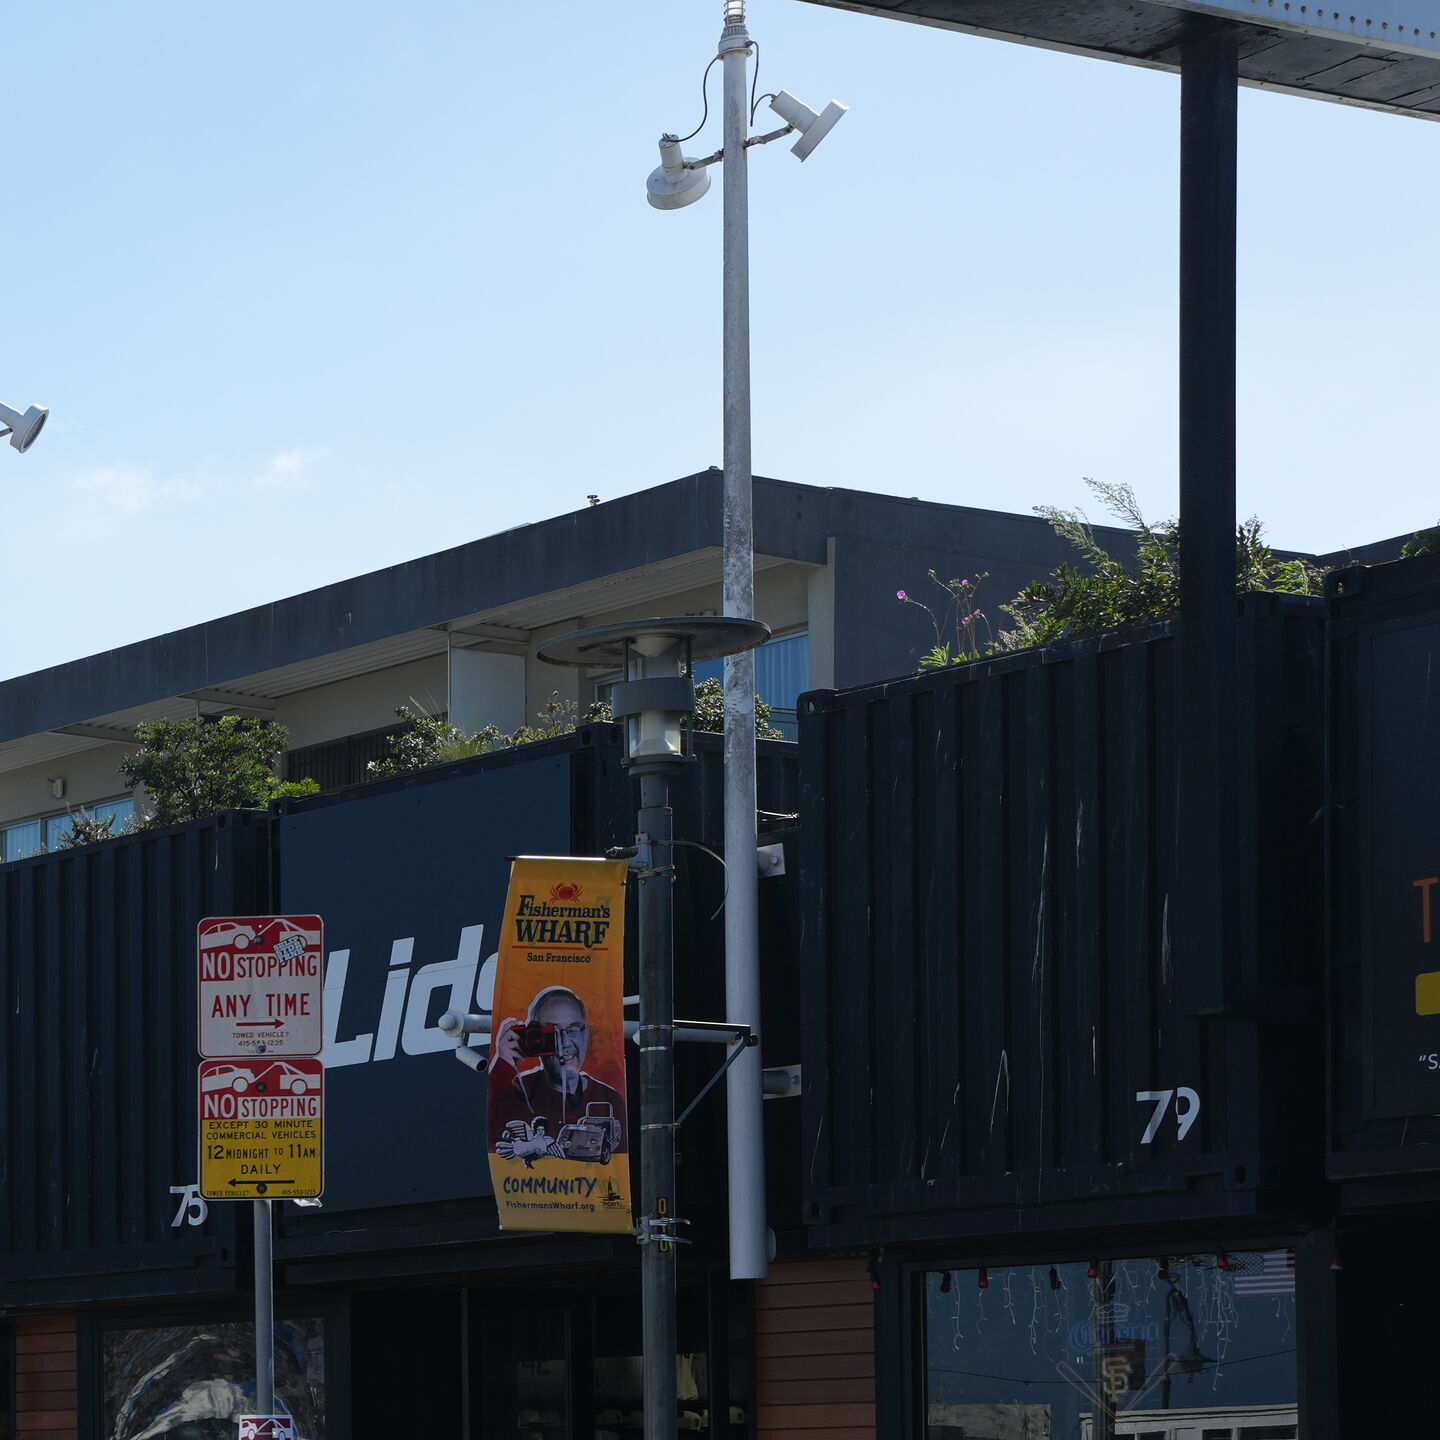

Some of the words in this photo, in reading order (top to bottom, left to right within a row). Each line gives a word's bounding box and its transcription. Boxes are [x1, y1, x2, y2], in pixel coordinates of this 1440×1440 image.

[516, 894, 610, 918] Fisherman's
[515, 919, 610, 949] WHARF
[202, 952, 231, 980] NO
[237, 954, 317, 978] STOPPING
[527, 952, 544, 963] San
[546, 952, 591, 963] Francisco
[211, 994, 251, 1018] ANY
[266, 993, 310, 1017] TIME
[204, 1094, 235, 1119] NO
[241, 1098, 316, 1117] STOPPING
[1136, 1087, 1200, 1144] 79
[207, 1131, 266, 1140] COMMERCIAL
[272, 1130, 316, 1139] VEHICLES
[209, 1121, 248, 1129] EXCEPT
[255, 1121, 268, 1129] 30
[274, 1120, 312, 1128] MINUTE
[241, 1164, 280, 1174] DAILY
[503, 1176, 598, 1198] COMMUNITY
[169, 1184, 209, 1227] 75
[506, 1200, 595, 1212] FishermansWharf.org
